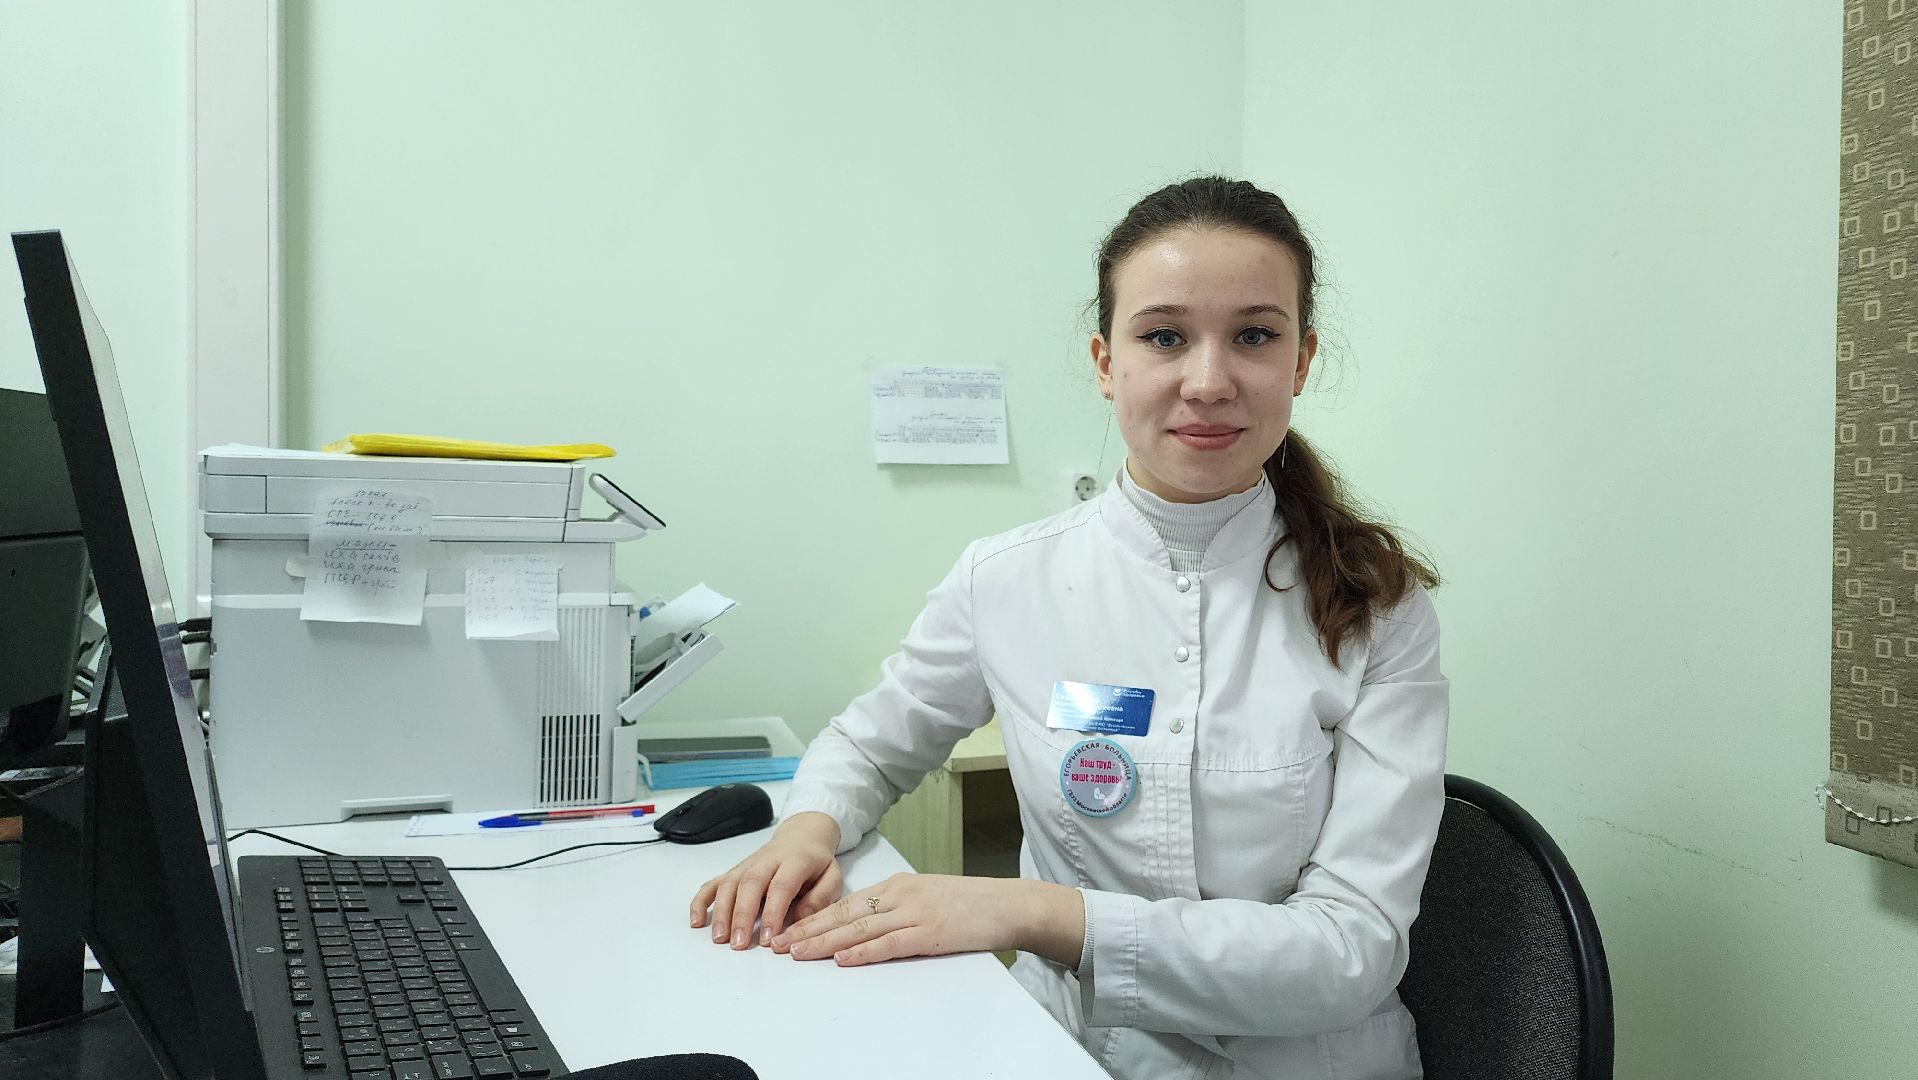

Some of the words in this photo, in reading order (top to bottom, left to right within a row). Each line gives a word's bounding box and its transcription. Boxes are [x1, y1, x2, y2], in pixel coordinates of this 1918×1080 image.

[1063, 742, 1100, 777] ЕГОРЬЕВСКАЯ
[1104, 744, 1132, 781] БОЛЬНИЦА
[1079, 757, 1095, 768] Наш
[1096, 759, 1112, 770] труд
[1071, 773, 1089, 783] ваше
